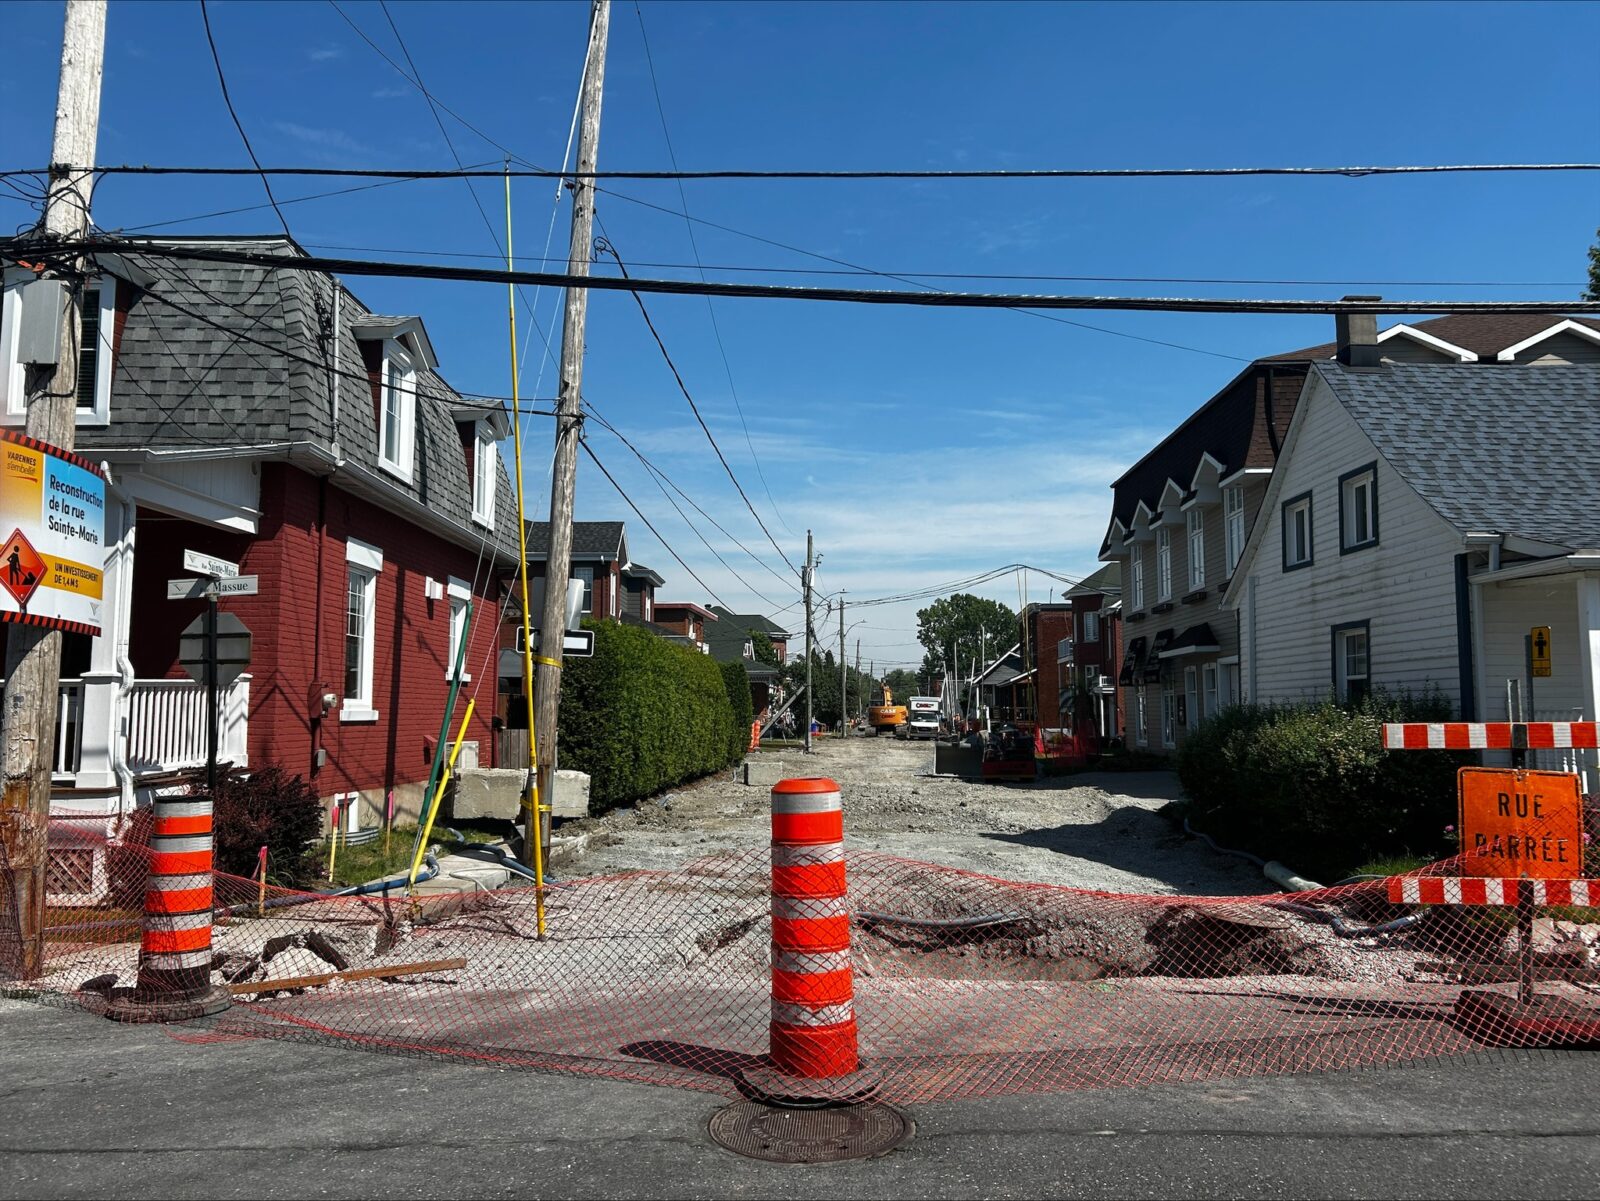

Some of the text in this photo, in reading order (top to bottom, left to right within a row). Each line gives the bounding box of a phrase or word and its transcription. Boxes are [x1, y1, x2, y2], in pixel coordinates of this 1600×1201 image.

[7, 451, 36, 466] VARENNES
[49, 474, 103, 509] Reconstruction
[48, 495, 85, 520] de la rue
[48, 515, 98, 545] Sainte-Marie
[54, 562, 99, 583] UN INVESTISSEMENT
[54, 574, 62, 584] DE
[208, 560, 238, 577] Sainte-Marie
[212, 581, 249, 592] Massue
[1498, 792, 1545, 819] RUE
[1475, 831, 1569, 863] BARRÉE
